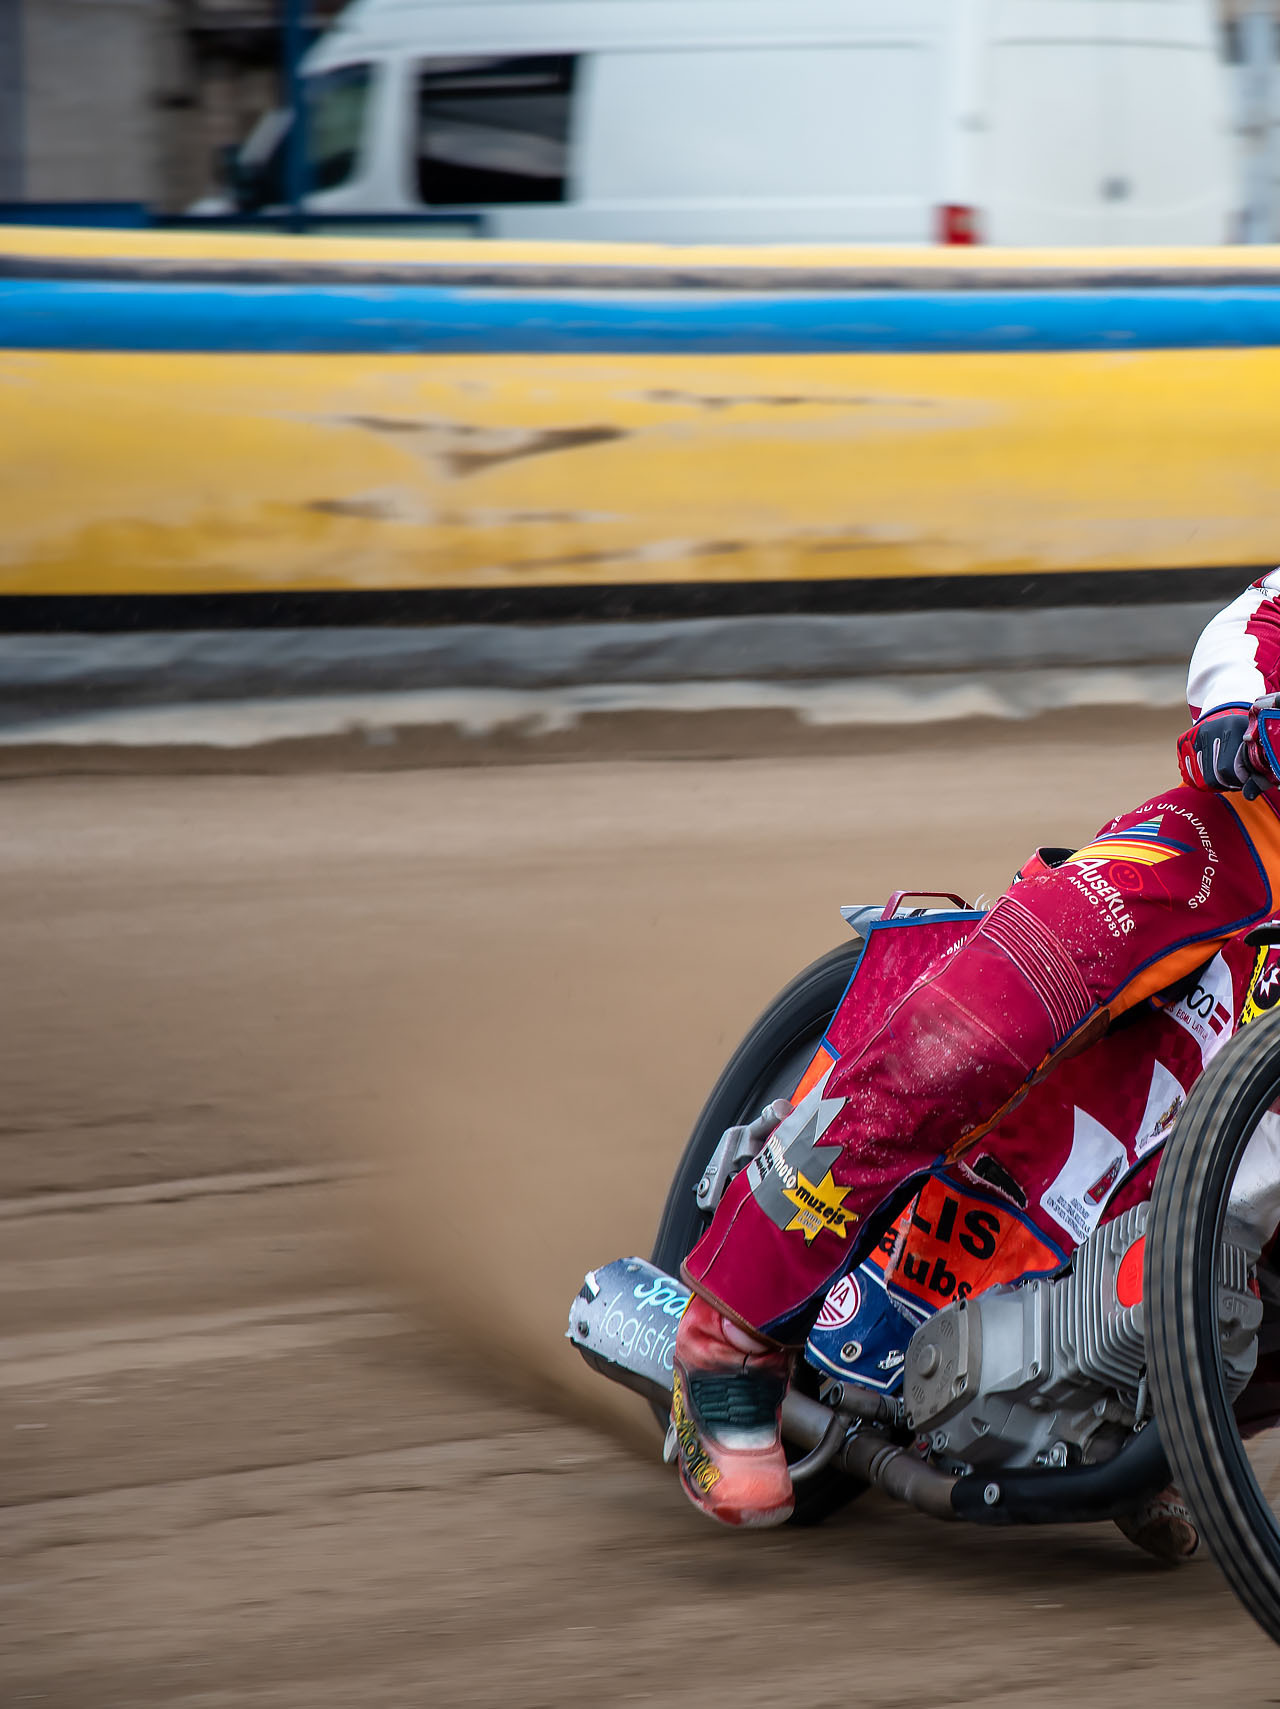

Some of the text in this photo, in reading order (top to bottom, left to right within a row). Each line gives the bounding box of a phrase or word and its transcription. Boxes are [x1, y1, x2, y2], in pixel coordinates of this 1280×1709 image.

[1057, 858, 1135, 934] AUSEKLIS
[1066, 876, 1121, 937] ANNO 1989
[795, 1185, 846, 1225] muzejs
